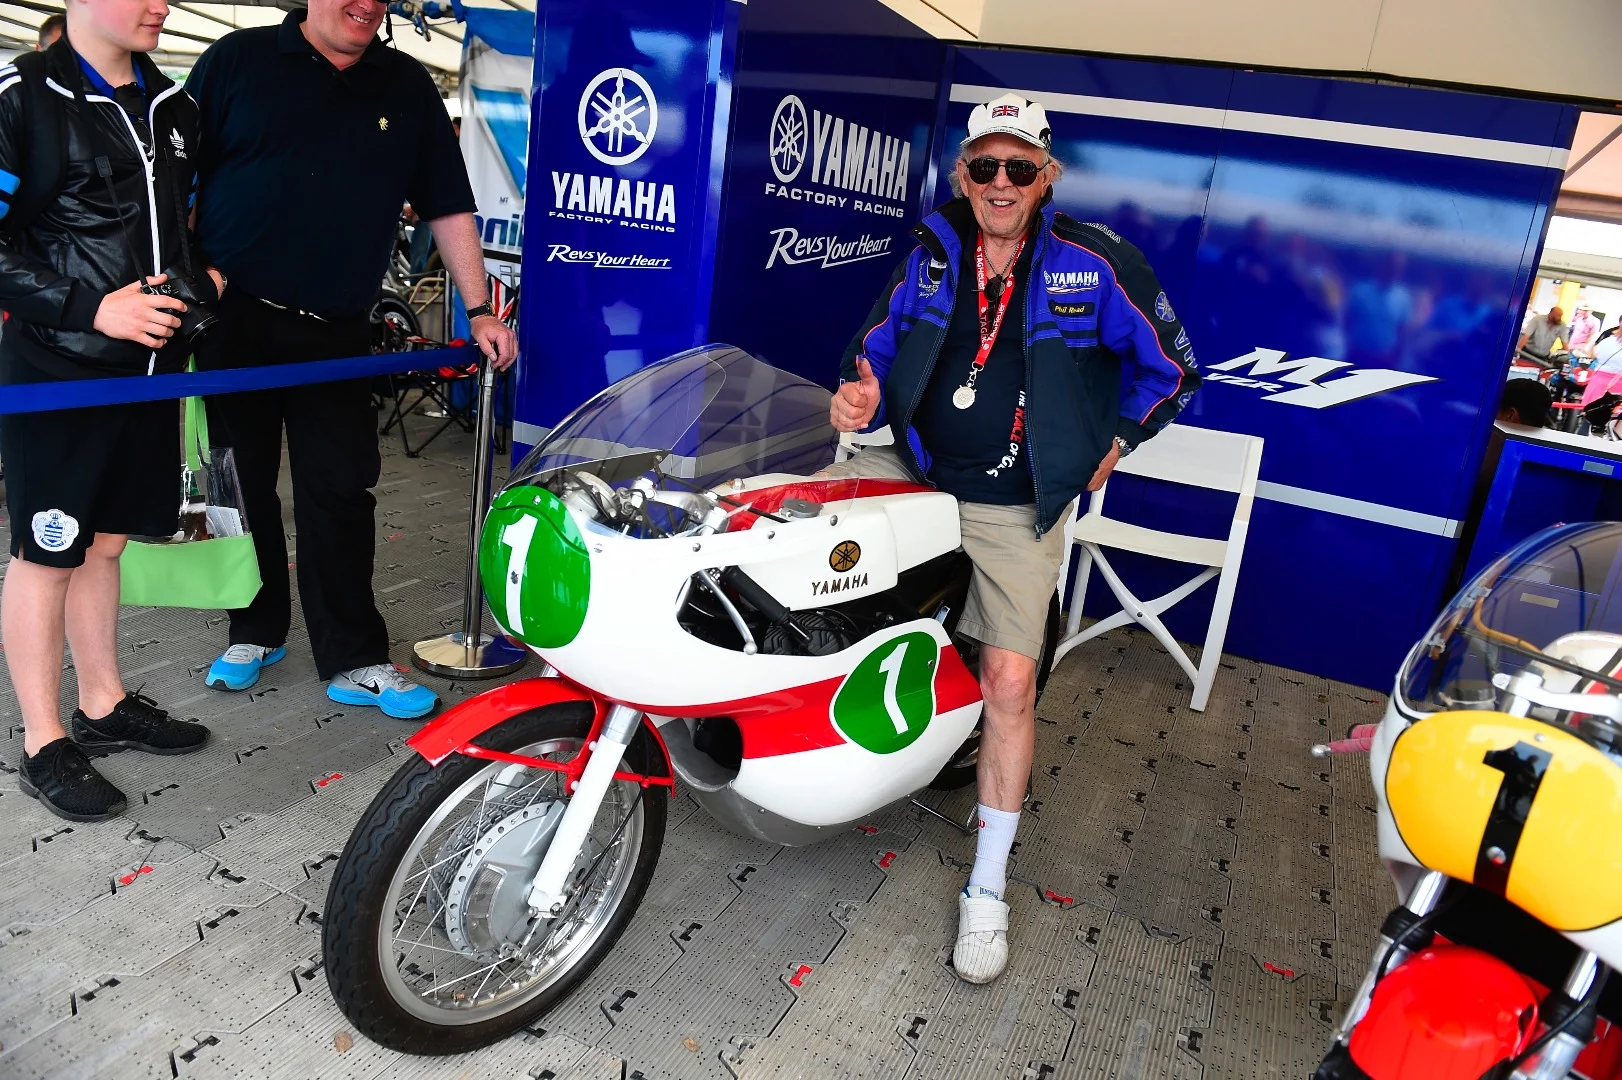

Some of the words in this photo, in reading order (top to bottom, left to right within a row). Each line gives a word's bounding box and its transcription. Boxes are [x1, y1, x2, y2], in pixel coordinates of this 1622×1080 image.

[811, 109, 911, 202] YAMAHA
[551, 171, 676, 223] YAMAHA
[765, 183, 848, 208] FACTORY
[854, 200, 904, 218] RACING
[549, 211, 613, 225] FACTORY
[620, 220, 676, 233] RACING
[547, 244, 597, 263] Revs
[594, 251, 631, 268] Your
[629, 254, 672, 268] Heart
[765, 227, 826, 269] Revs
[821, 236, 858, 268] Your
[856, 234, 892, 257] Heart
[1051, 271, 1099, 285] YAMAHA
[501, 514, 539, 636] 1
[811, 572, 869, 597] YAMAHA
[879, 642, 910, 735] 1
[1473, 739, 1554, 900] 1
